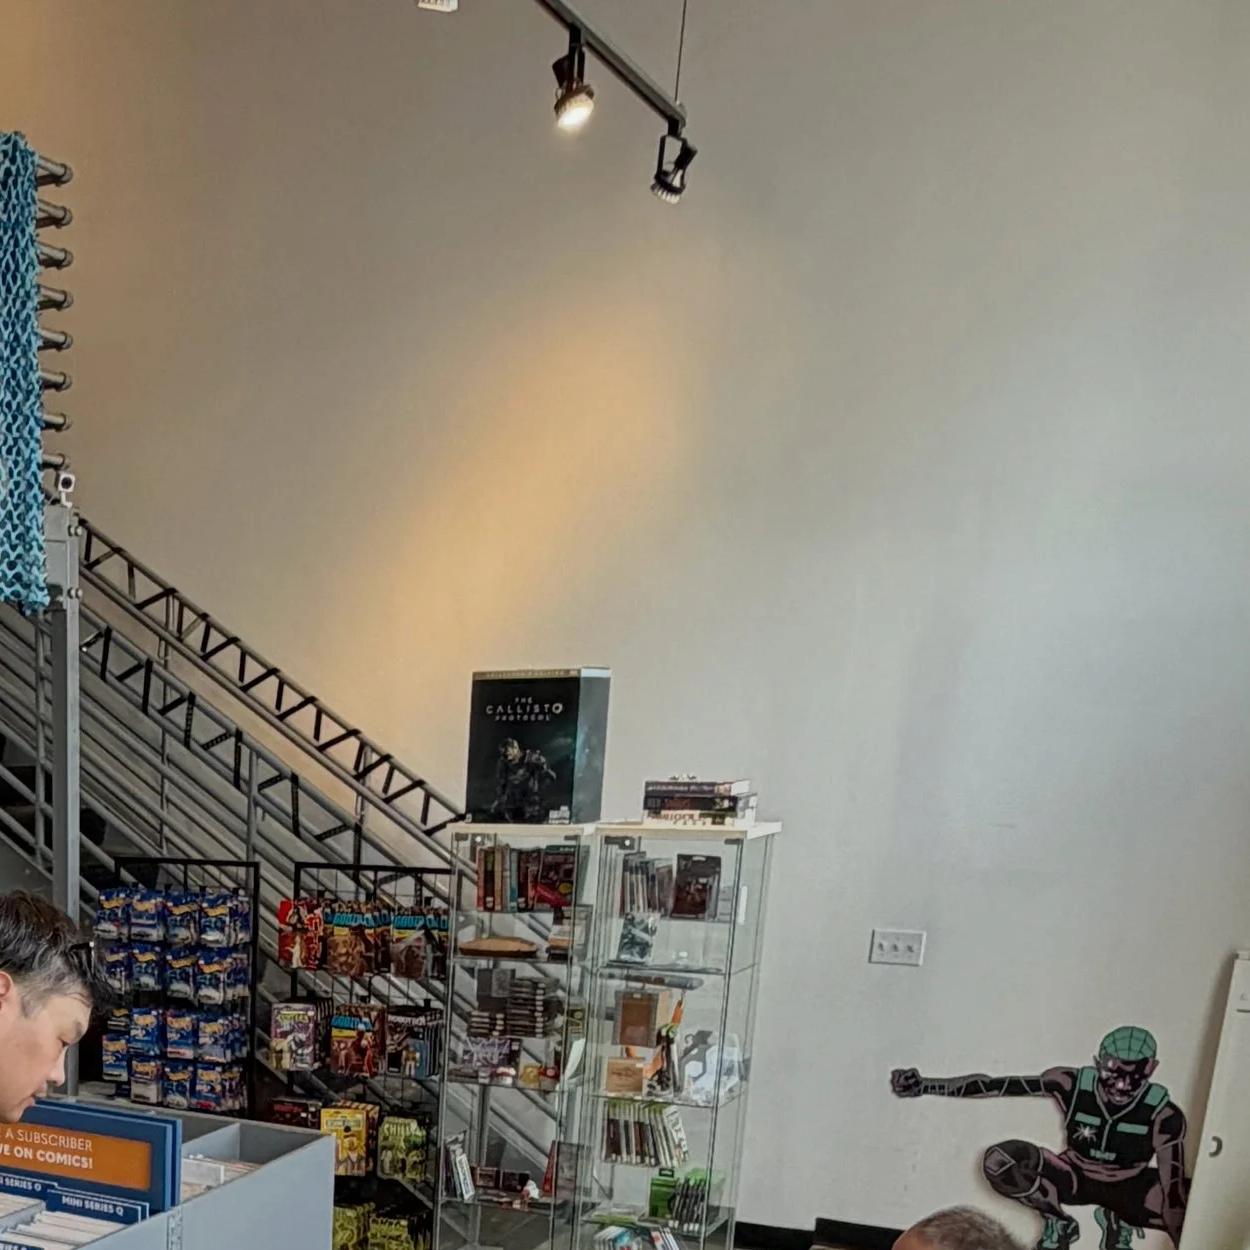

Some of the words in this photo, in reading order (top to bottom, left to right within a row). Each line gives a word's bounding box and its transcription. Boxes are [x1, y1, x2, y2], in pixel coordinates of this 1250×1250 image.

[486, 703, 563, 714] CALLISTO
[5, 1128, 14, 1140] A
[18, 1131, 92, 1152] SUBSCRIBER
[14, 1147, 33, 1160] ON
[36, 1149, 93, 1169] COMICS!
[5, 1177, 32, 1189] SERIES
[61, 1195, 81, 1206] MINI
[83, 1199, 114, 1213] SERIES
[115, 1206, 124, 1217] Q
